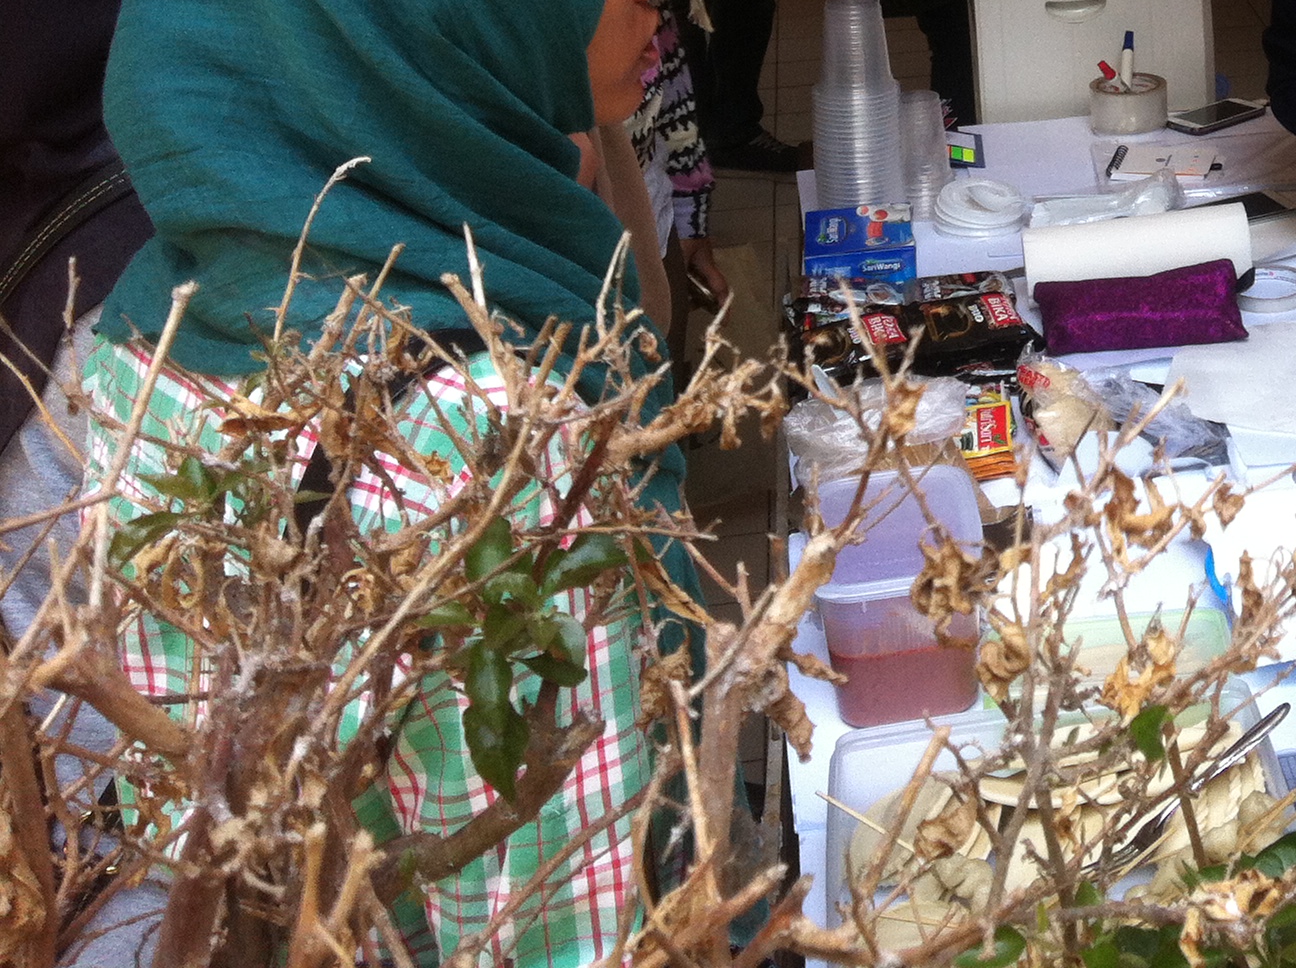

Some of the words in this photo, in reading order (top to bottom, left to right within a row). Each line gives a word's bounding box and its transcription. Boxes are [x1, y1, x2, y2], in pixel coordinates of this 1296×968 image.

[862, 262, 901, 273] SariWangi
[968, 304, 984, 323] DUO
[988, 297, 1007, 321] BIKA
